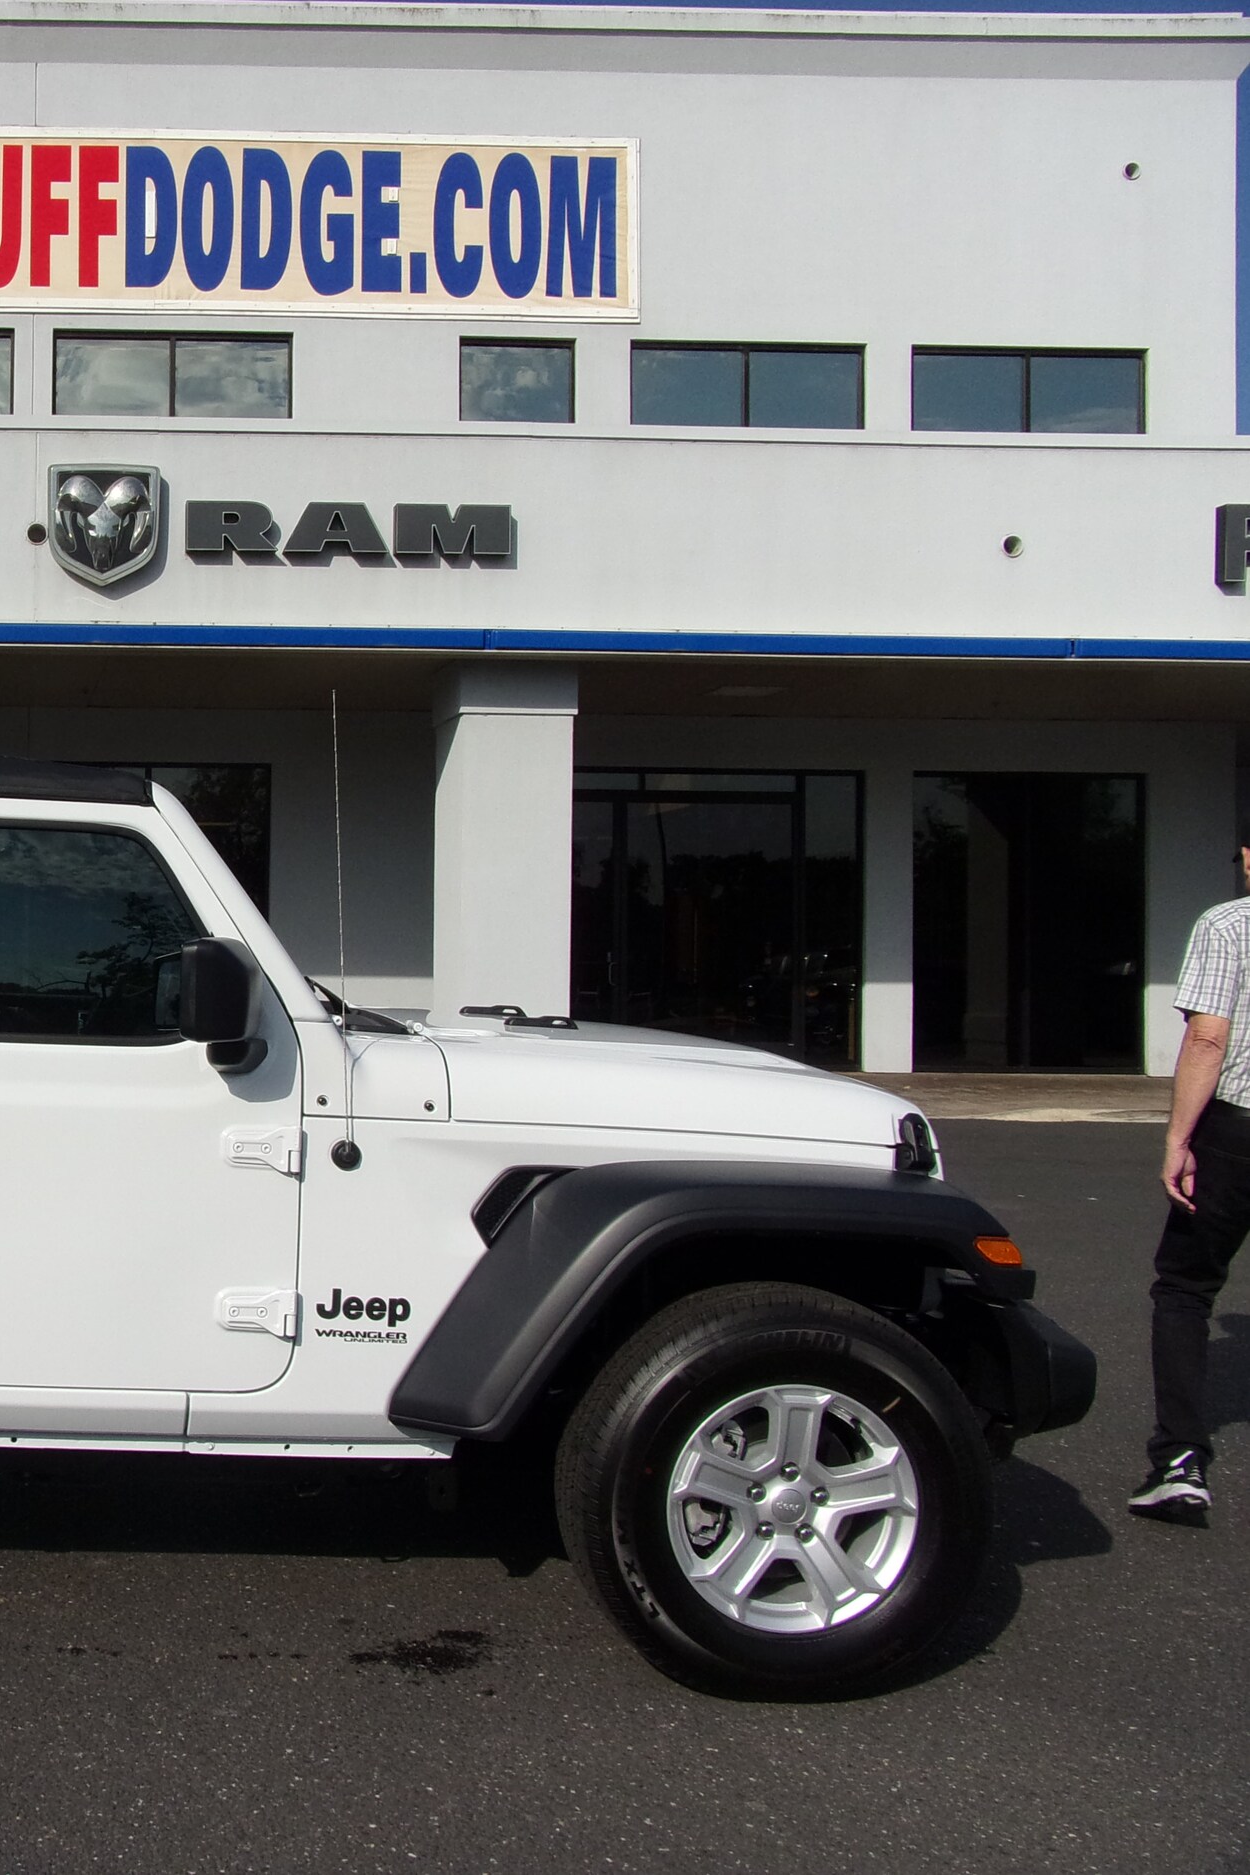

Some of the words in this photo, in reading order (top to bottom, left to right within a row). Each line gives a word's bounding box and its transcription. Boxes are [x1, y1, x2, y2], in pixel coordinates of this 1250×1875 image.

[185, 499, 512, 556] RAM
[315, 1288, 411, 1328] Jeep
[314, 1328, 408, 1340] WRANGLER
[343, 1337, 408, 1345] UNLIMITED
